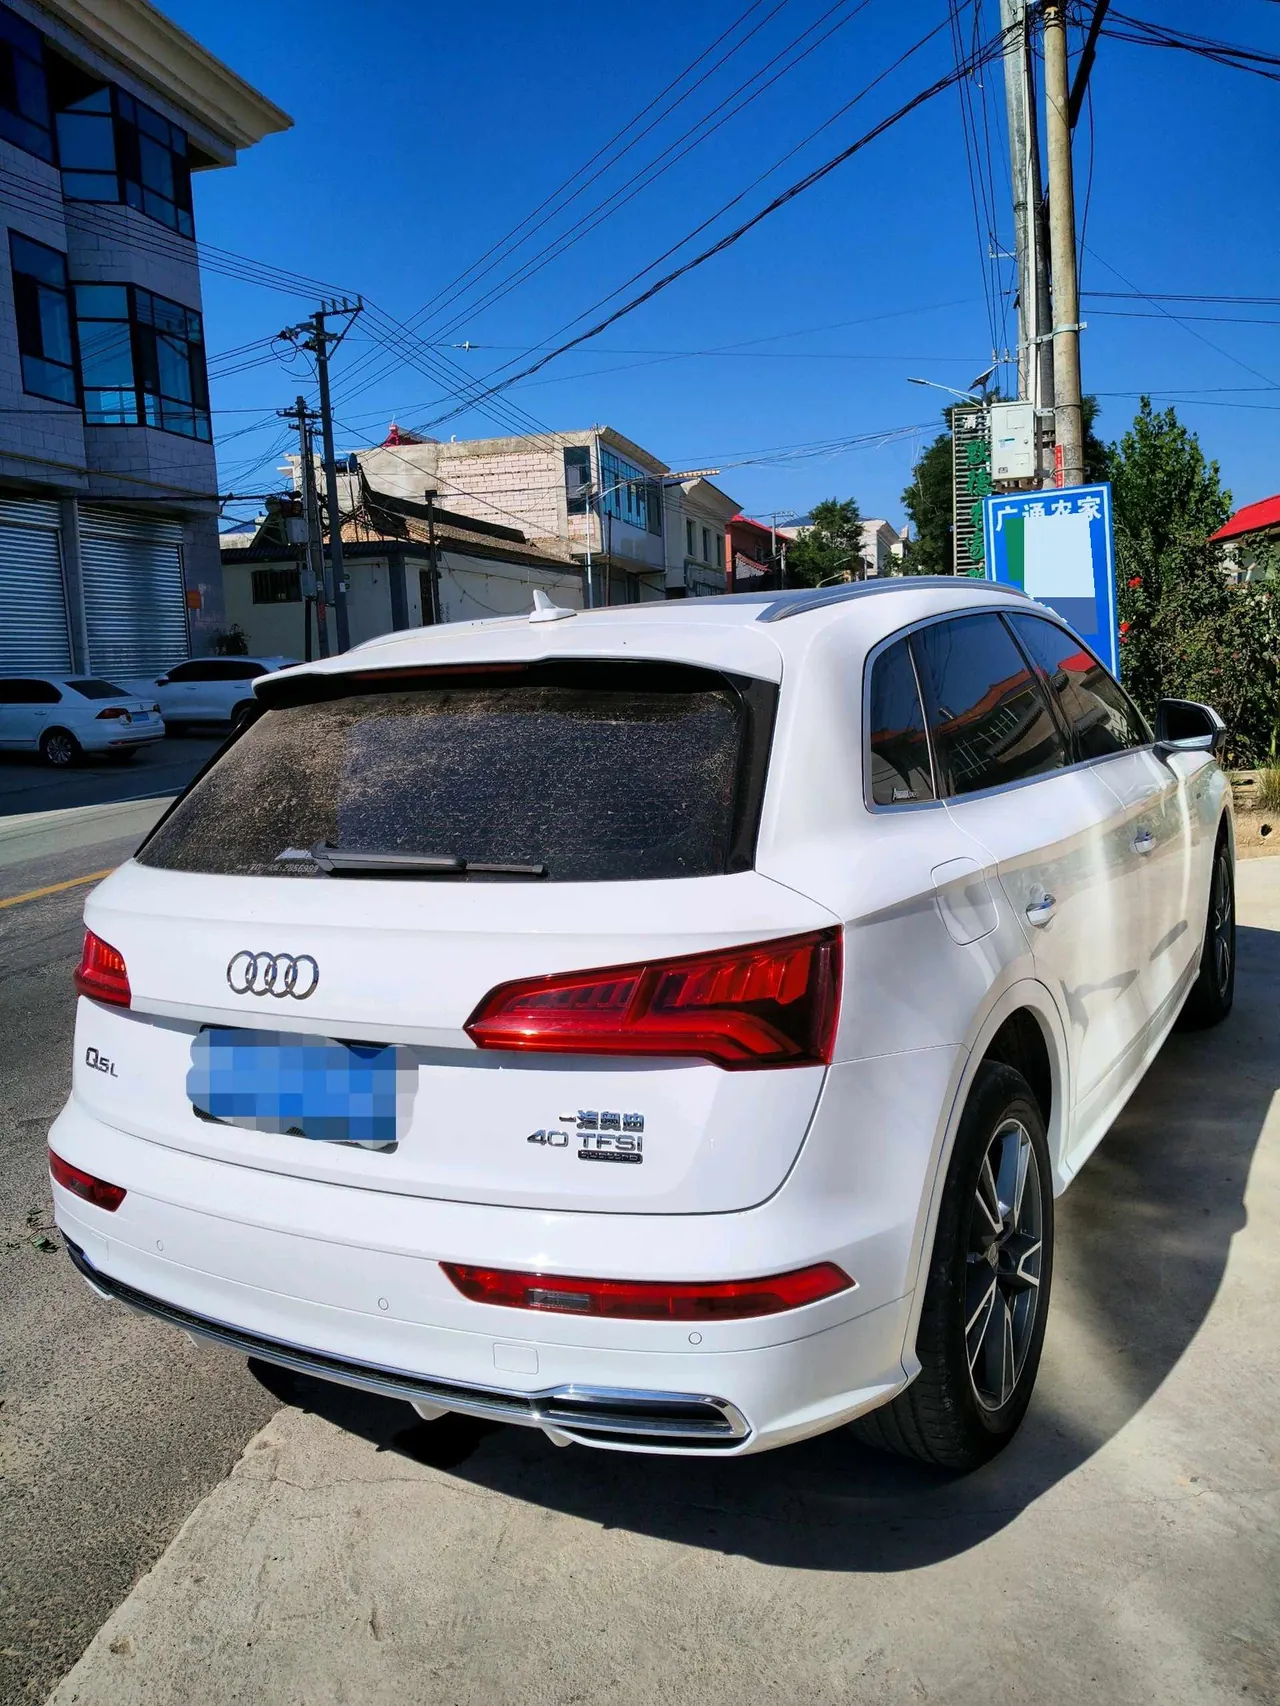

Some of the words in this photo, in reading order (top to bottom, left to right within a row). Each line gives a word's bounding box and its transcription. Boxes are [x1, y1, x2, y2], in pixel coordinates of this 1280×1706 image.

[85, 1046, 119, 1078] Q5L
[526, 1129, 569, 1147] 40
[576, 1132, 643, 1152] TFSI
